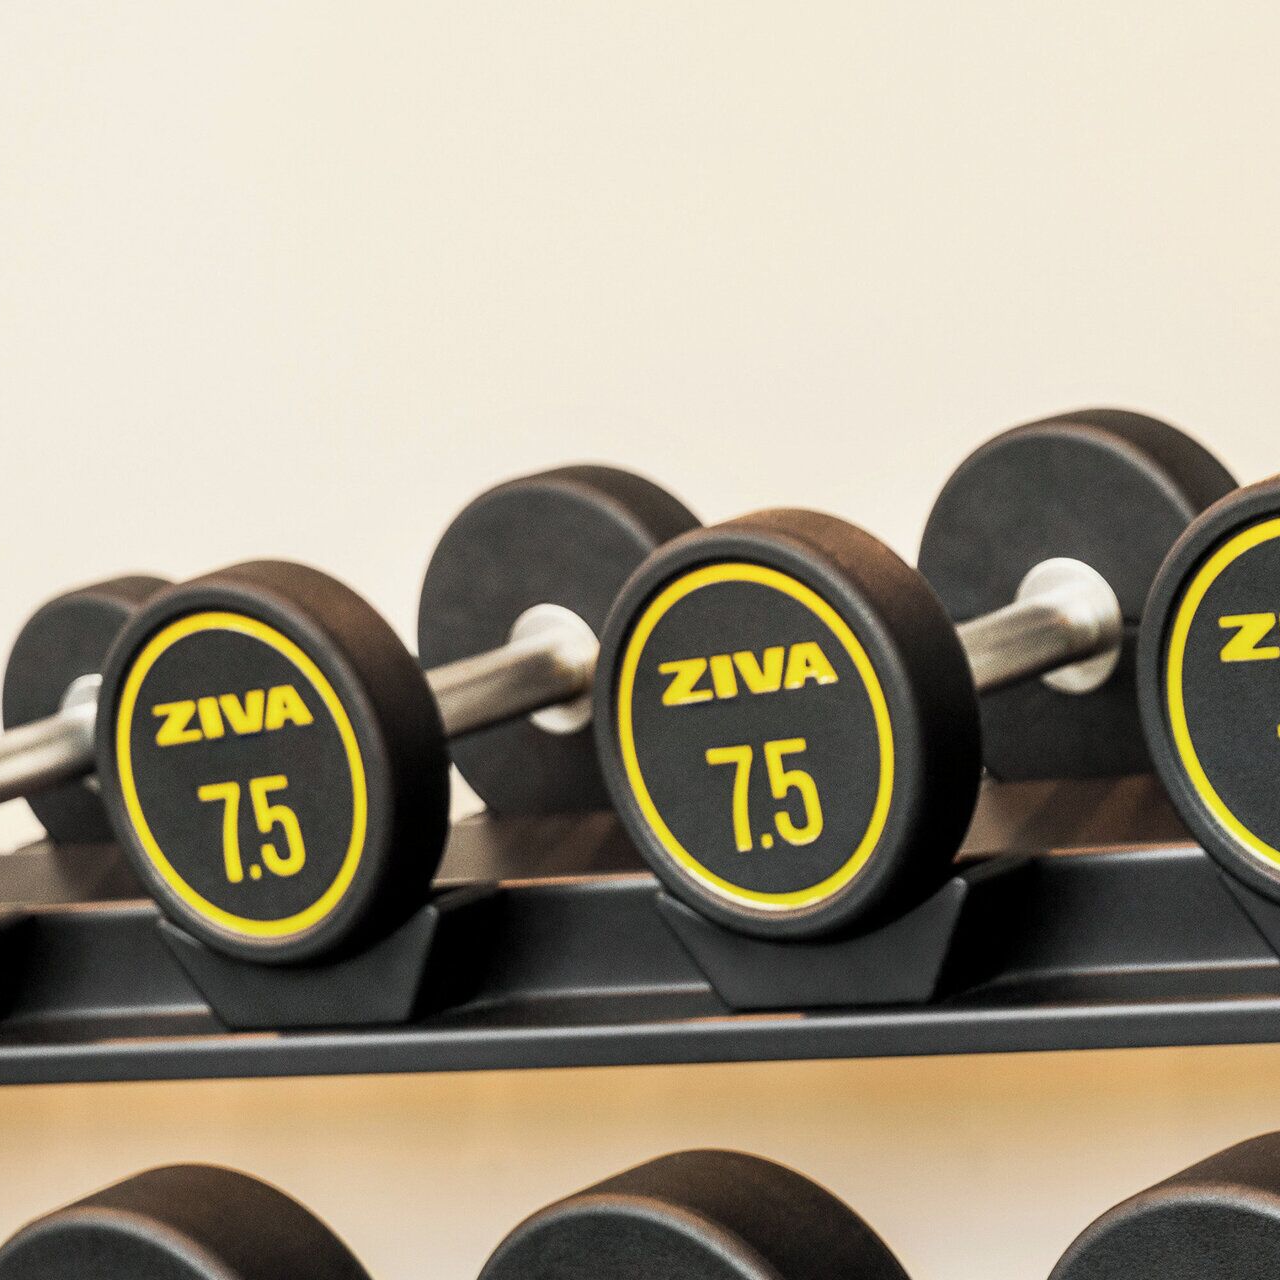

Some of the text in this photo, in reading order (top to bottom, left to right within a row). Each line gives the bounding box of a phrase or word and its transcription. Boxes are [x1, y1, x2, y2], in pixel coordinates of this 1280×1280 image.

[151, 684, 313, 747] ZIVA
[657, 641, 839, 707] ZIVA
[197, 775, 306, 884] 7.5
[705, 737, 824, 850] 7.5
